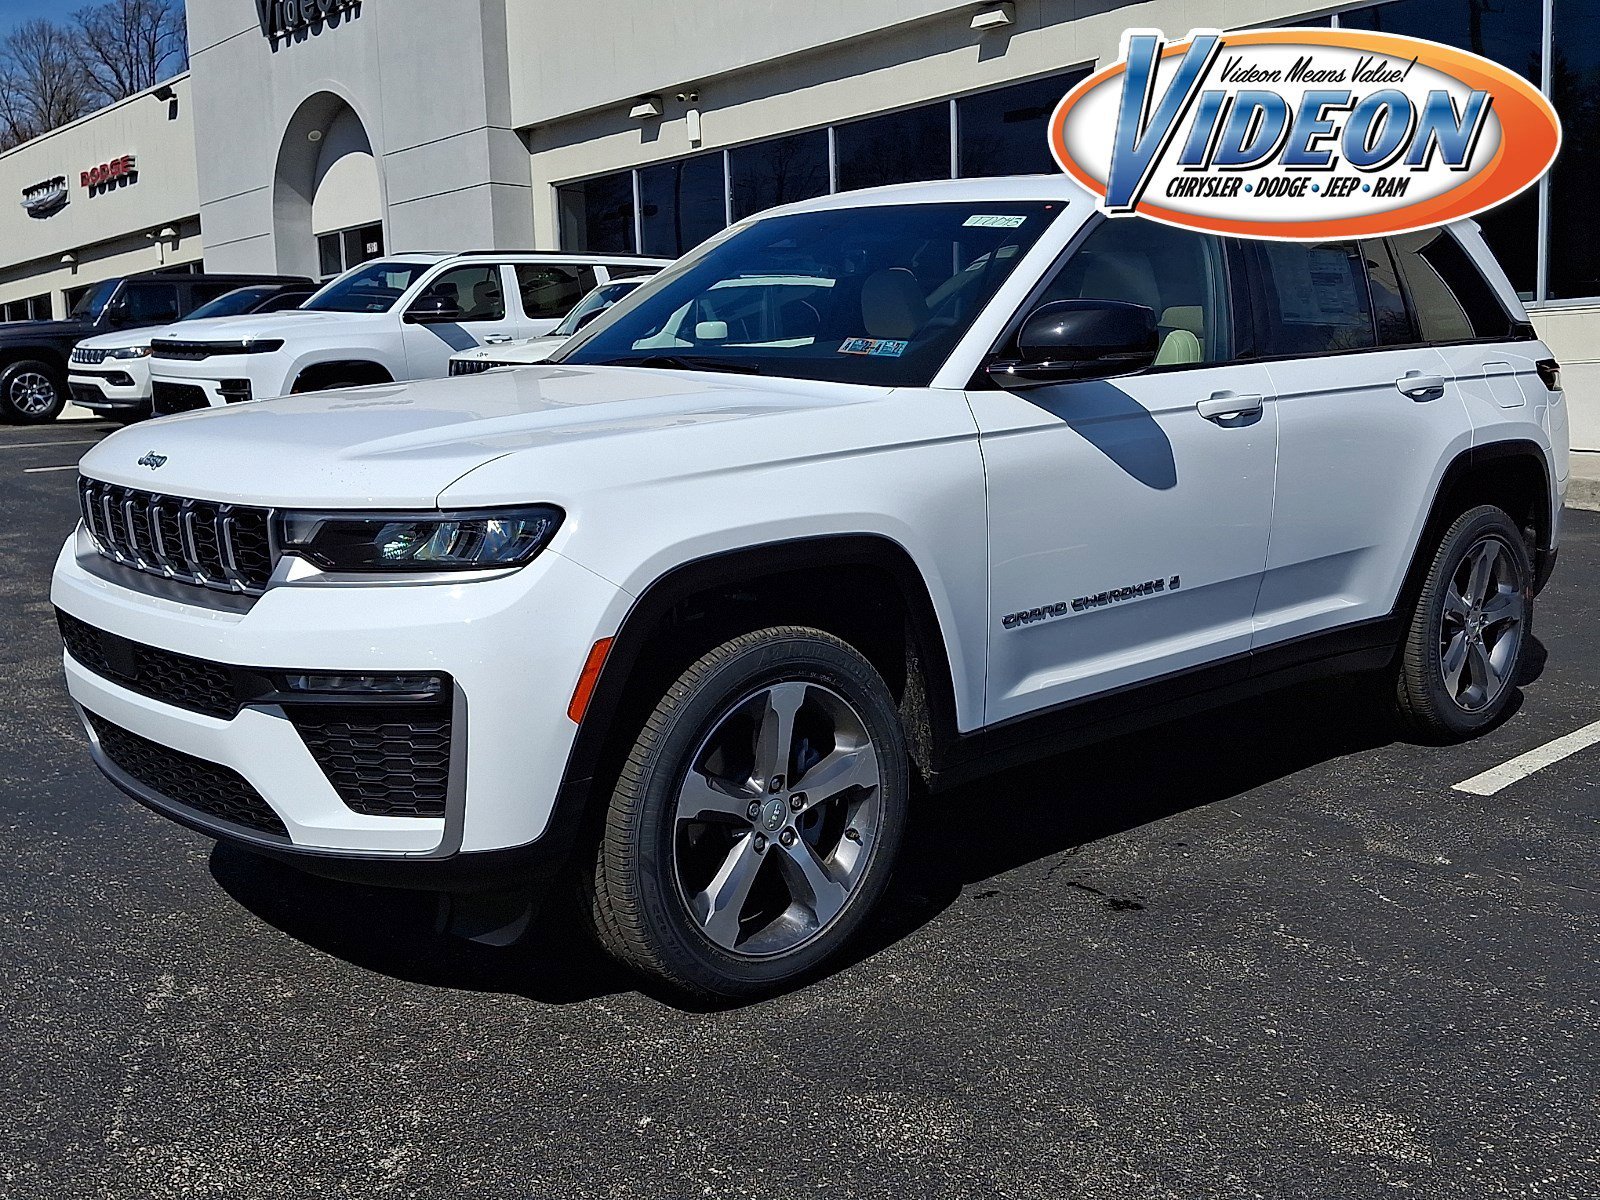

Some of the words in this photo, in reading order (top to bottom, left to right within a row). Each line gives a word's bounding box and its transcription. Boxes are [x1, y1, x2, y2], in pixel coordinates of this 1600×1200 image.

[80, 154, 135, 188] DODGE
[138, 450, 167, 470] Jeep
[1001, 602, 1068, 629] GRAND
[1070, 578, 1165, 612] CHEROKEE
